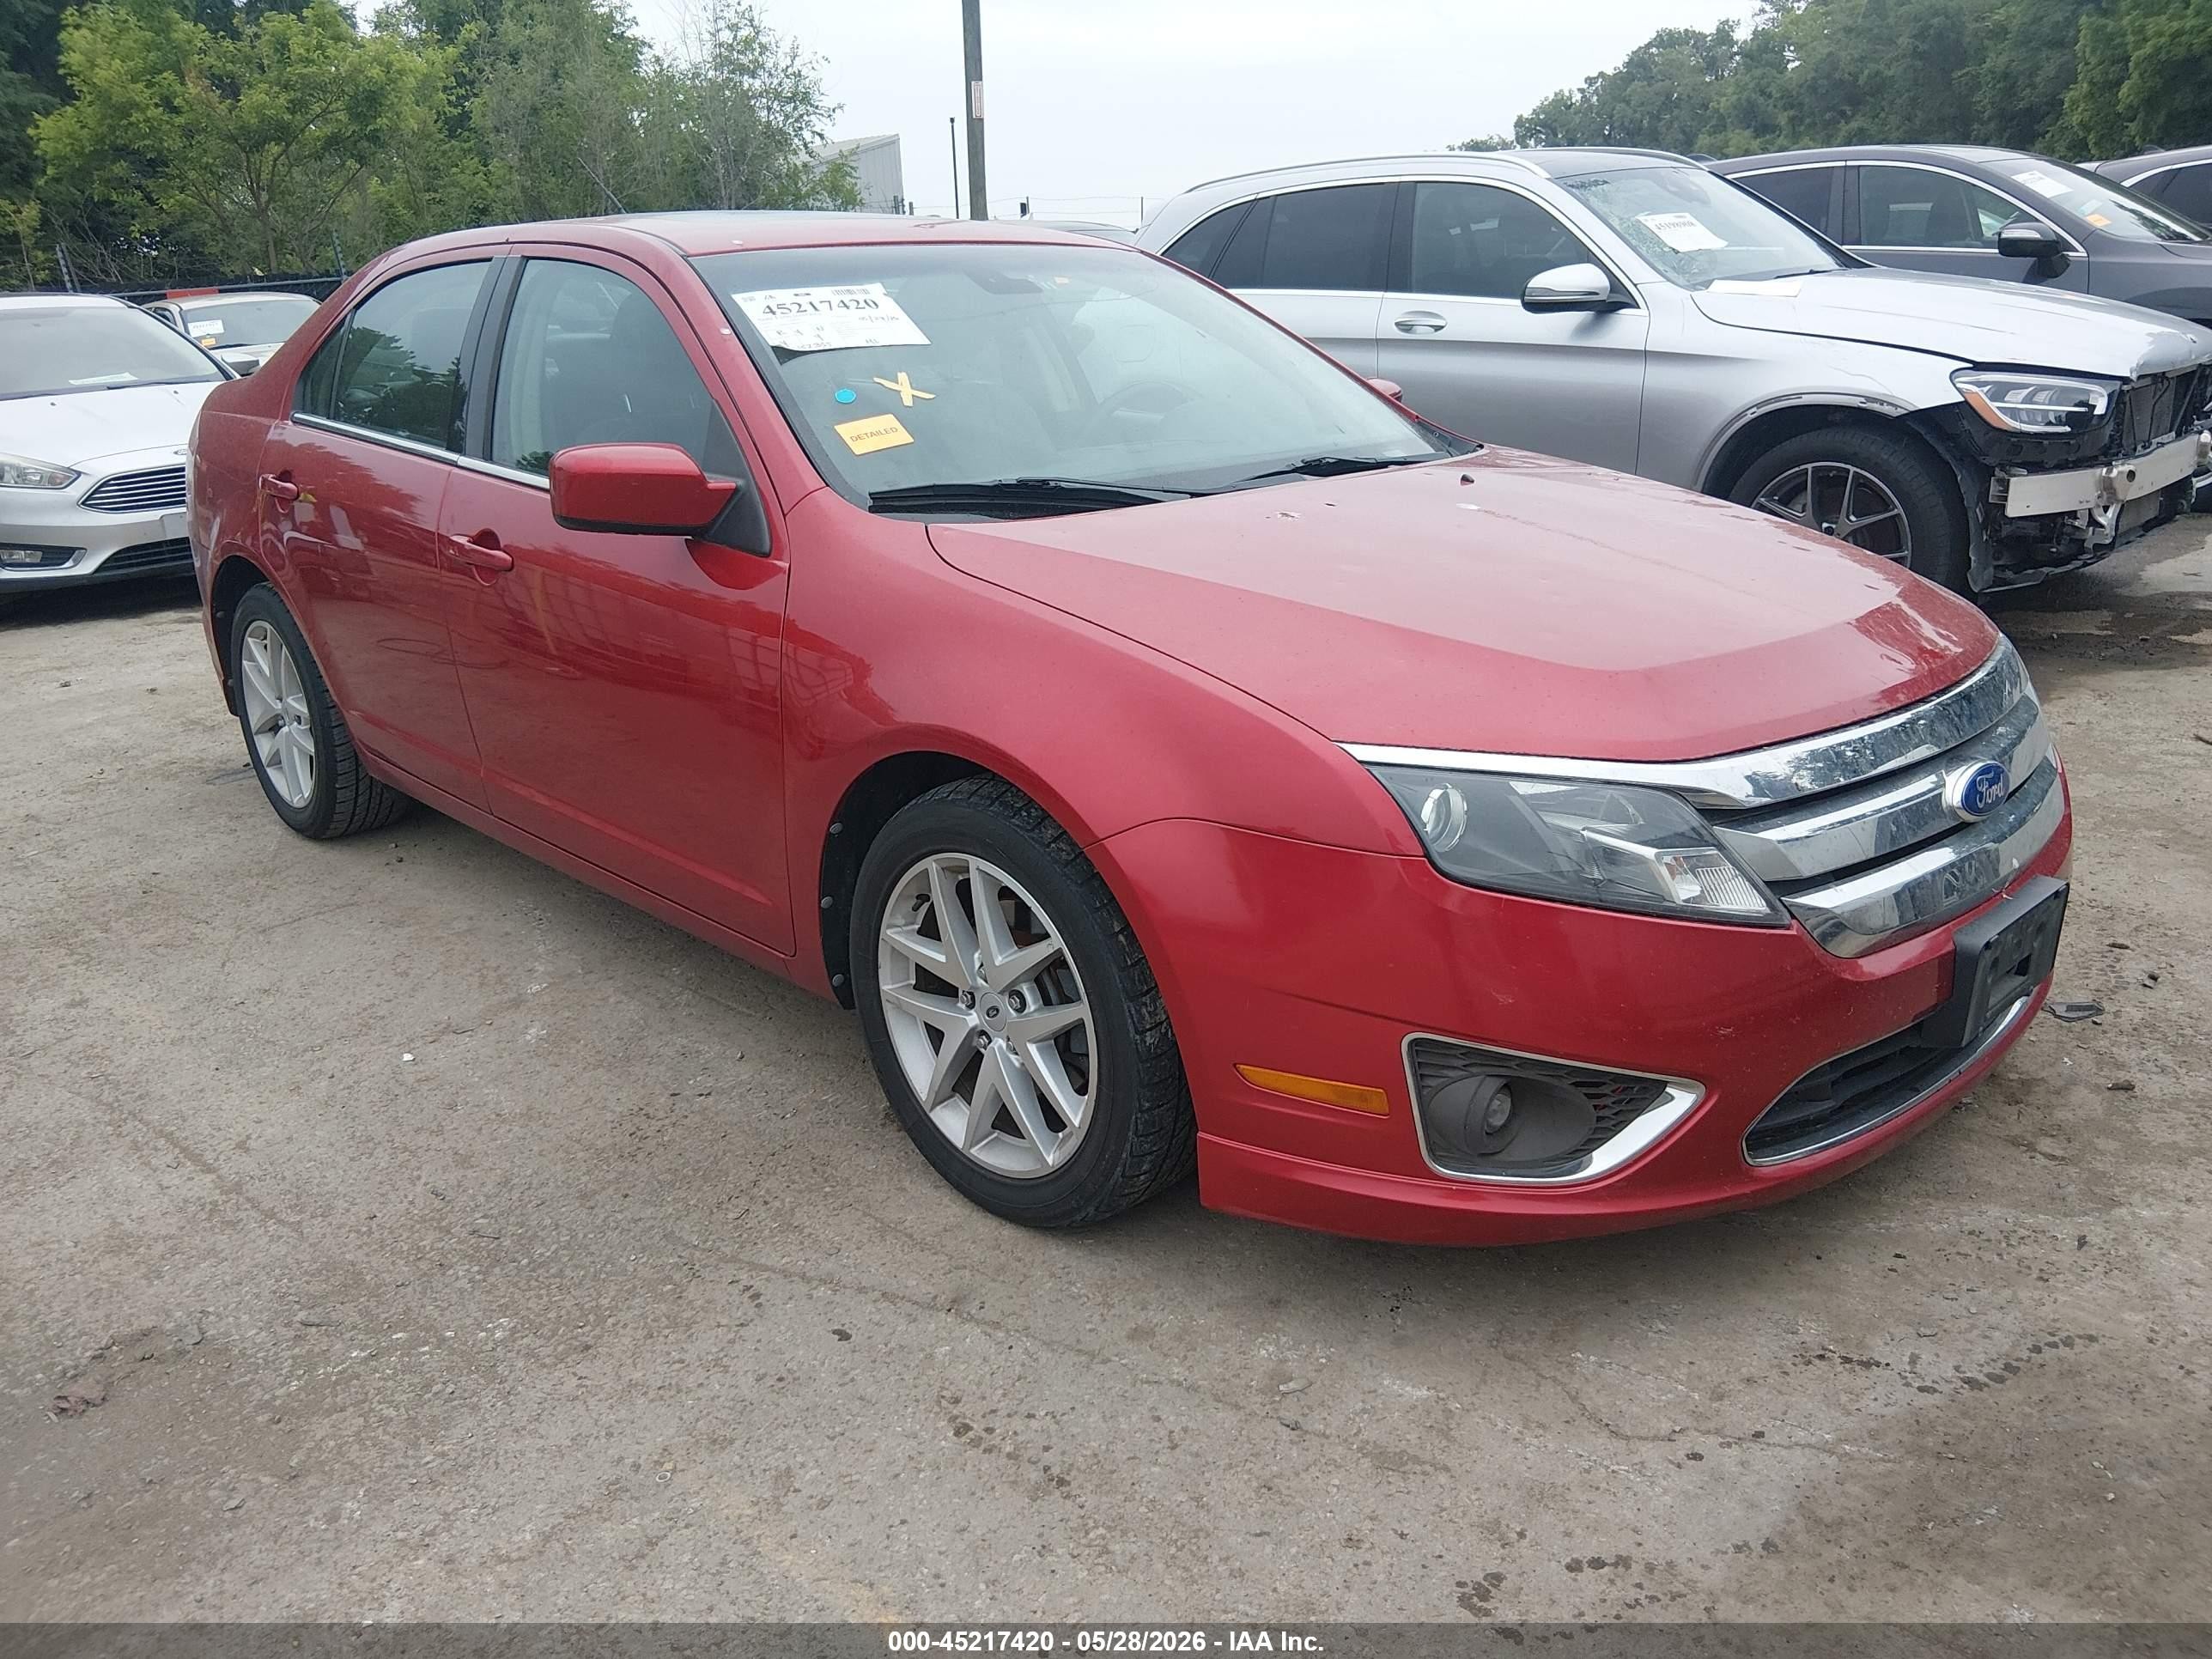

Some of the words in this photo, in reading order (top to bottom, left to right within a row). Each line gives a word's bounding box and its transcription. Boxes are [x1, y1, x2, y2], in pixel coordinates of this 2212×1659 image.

[763, 298, 879, 316] 45217420
[850, 427, 899, 442] DETAILED
[1976, 769, 2004, 809] Ford
